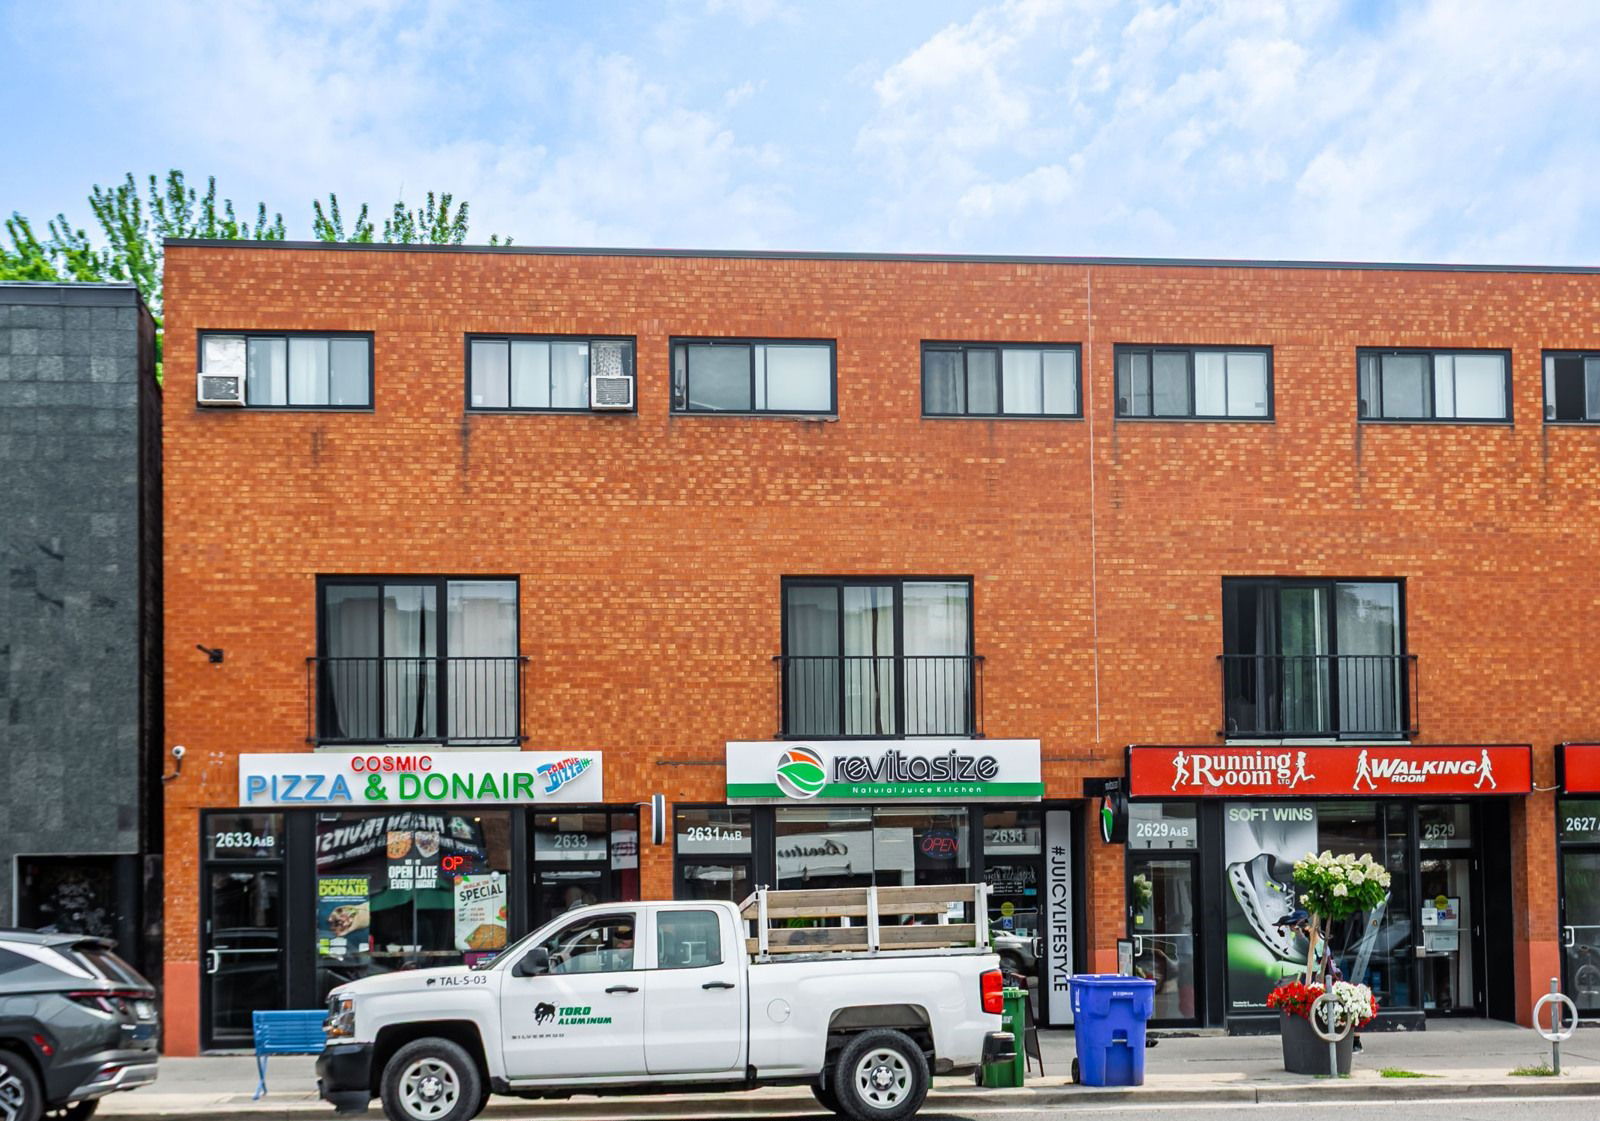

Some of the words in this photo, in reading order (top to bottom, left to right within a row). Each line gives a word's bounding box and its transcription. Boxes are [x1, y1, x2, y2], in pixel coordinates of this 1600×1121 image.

[351, 756, 432, 772] COSMIC
[833, 749, 999, 783] revitasize
[1191, 751, 1291, 786] Running
[1391, 775, 1426, 783] ROOM
[246, 774, 352, 802] PIZZA
[364, 774, 388, 801] &
[399, 773, 535, 800] DONAIR
[852, 786, 897, 794] Natural
[901, 786, 933, 794] Juice
[936, 786, 982, 794] Kitchen
[1229, 807, 1269, 822] SOFT
[1273, 807, 1313, 822] WINS
[1136, 823, 1168, 838] 2629
[1170, 827, 1189, 837] A&B
[1425, 824, 1455, 838] 2629
[1566, 817, 1597, 832] 2627
[216, 832, 252, 848] 2633
[253, 836, 275, 847] A&B
[554, 834, 588, 848] 2633
[687, 827, 720, 842] 2631
[722, 830, 742, 841] A&B
[921, 837, 960, 853] OPEN
[388, 865, 414, 879] OPEN
[415, 865, 438, 879] LATE
[319, 885, 368, 896] DONAIR
[391, 878, 413, 889] EVERY
[459, 883, 503, 902] SPECIAL
[1051, 846, 1068, 992] #JUICYLIFESTYLE
[439, 975, 487, 986] TAL-S-03
[558, 1006, 592, 1016] TORO
[558, 1017, 612, 1025] ALUMINUM
